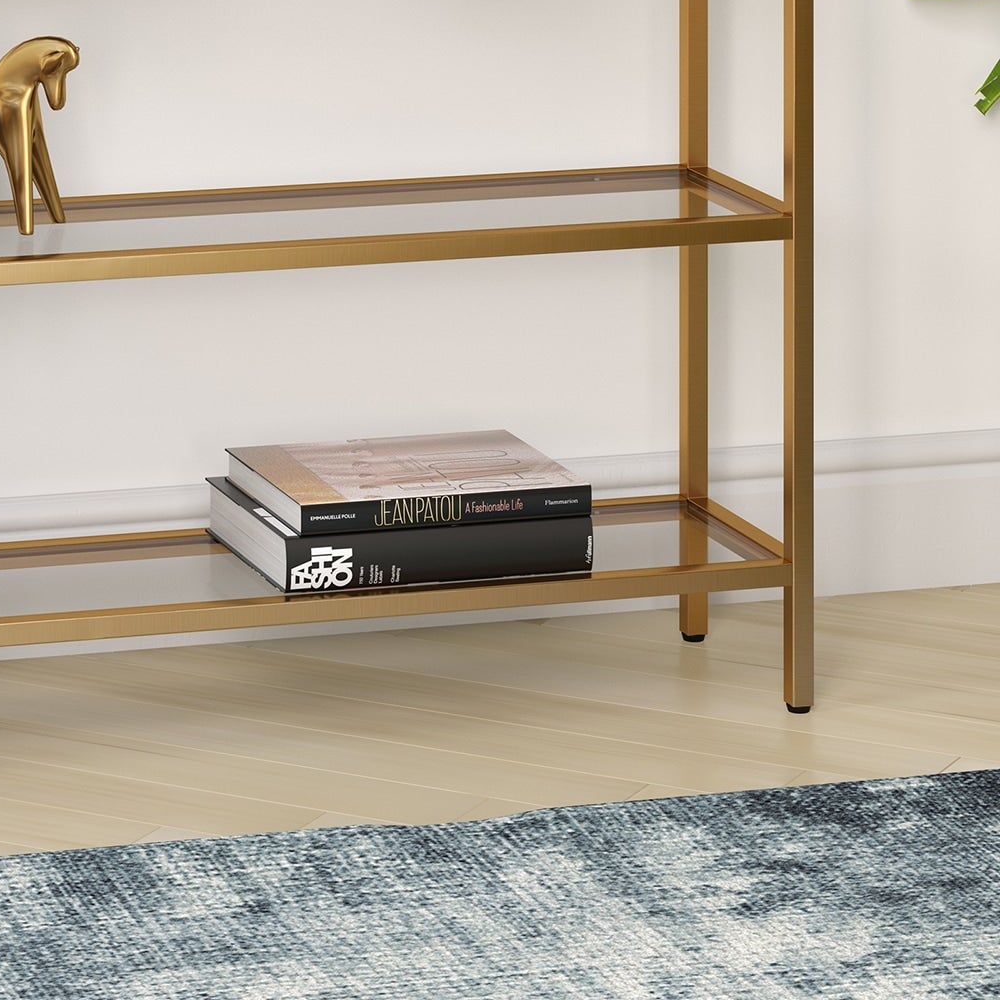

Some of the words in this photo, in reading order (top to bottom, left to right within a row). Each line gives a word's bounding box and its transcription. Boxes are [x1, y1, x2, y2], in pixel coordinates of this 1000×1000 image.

[374, 498, 414, 527] JEAN
[415, 494, 462, 523] PATOU
[465, 502, 471, 513] A
[471, 499, 510, 513] Fashionable
[511, 498, 524, 511] Life
[310, 513, 341, 522] EMMANUELLE
